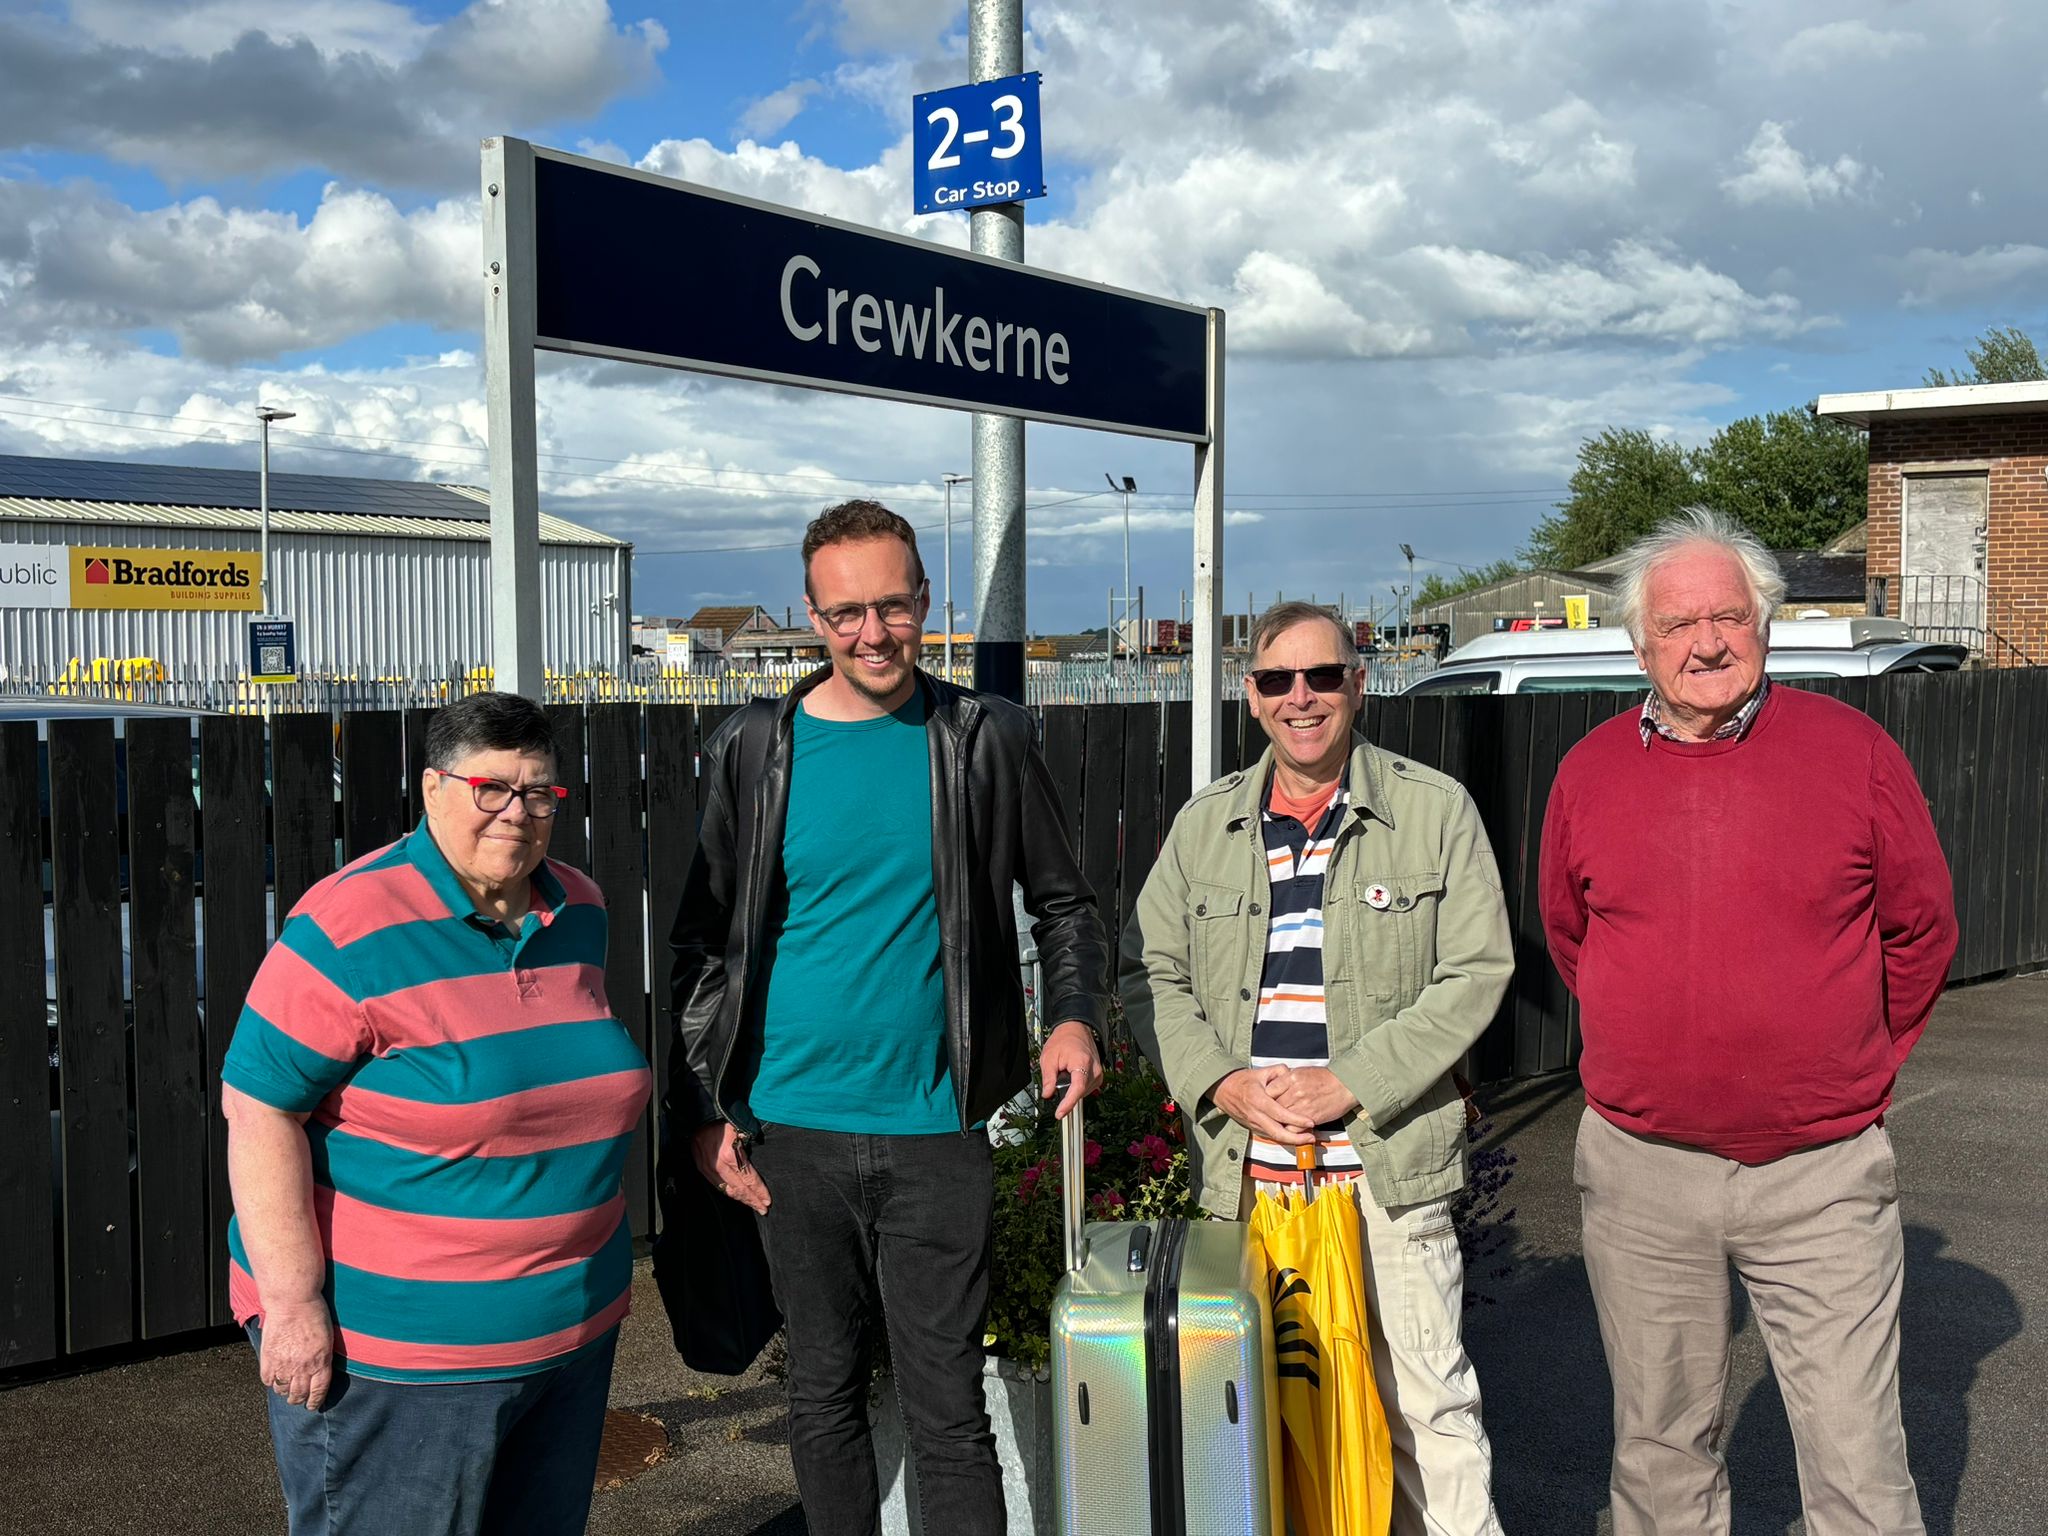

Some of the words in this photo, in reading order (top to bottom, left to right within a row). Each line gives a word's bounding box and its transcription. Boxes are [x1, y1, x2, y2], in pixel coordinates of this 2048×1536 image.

[927, 94, 1026, 170] 2-3
[934, 186, 968, 204] Car
[973, 179, 1020, 199] Stop
[780, 254, 1071, 385] Crewkerne
[113, 559, 250, 587] Bradfords
[170, 591, 211, 600] BUILDING
[214, 591, 251, 600] SUPPLIES
